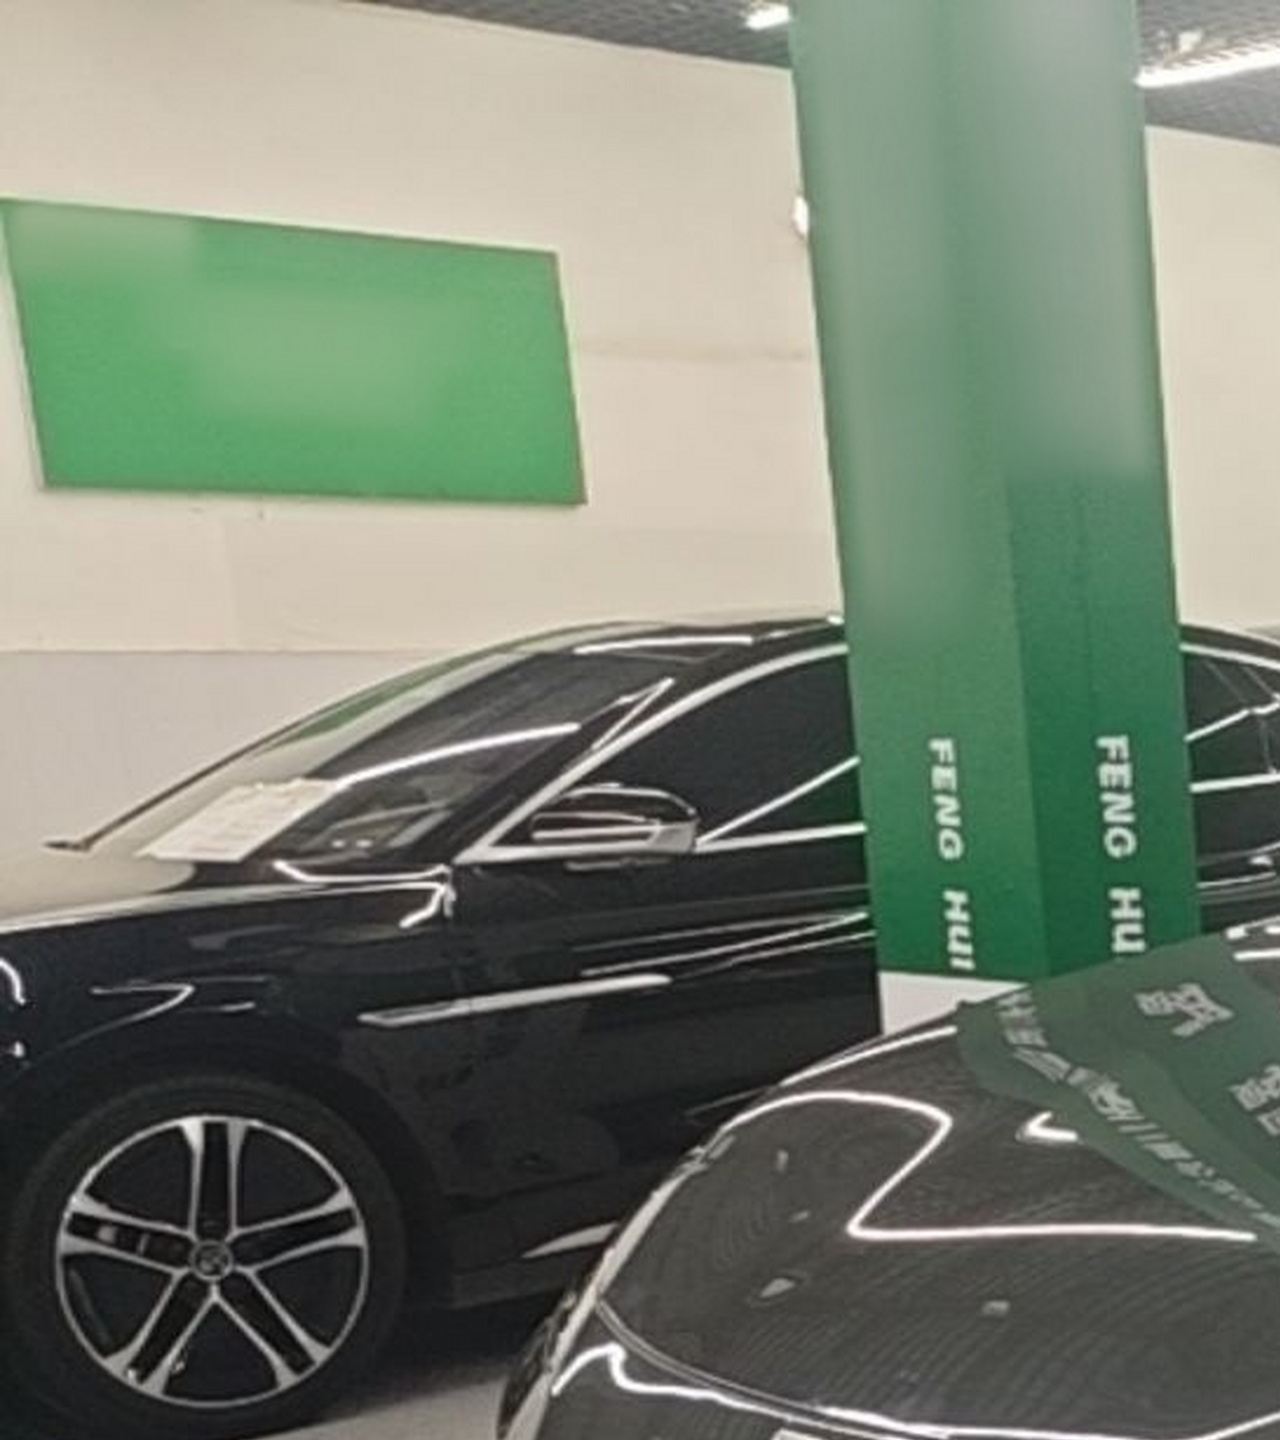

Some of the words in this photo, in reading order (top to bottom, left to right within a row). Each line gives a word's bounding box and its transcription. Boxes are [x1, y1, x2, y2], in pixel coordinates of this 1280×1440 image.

[927, 736, 965, 861] FENG
[1096, 734, 1138, 860] FENG
[942, 889, 976, 970] HUI
